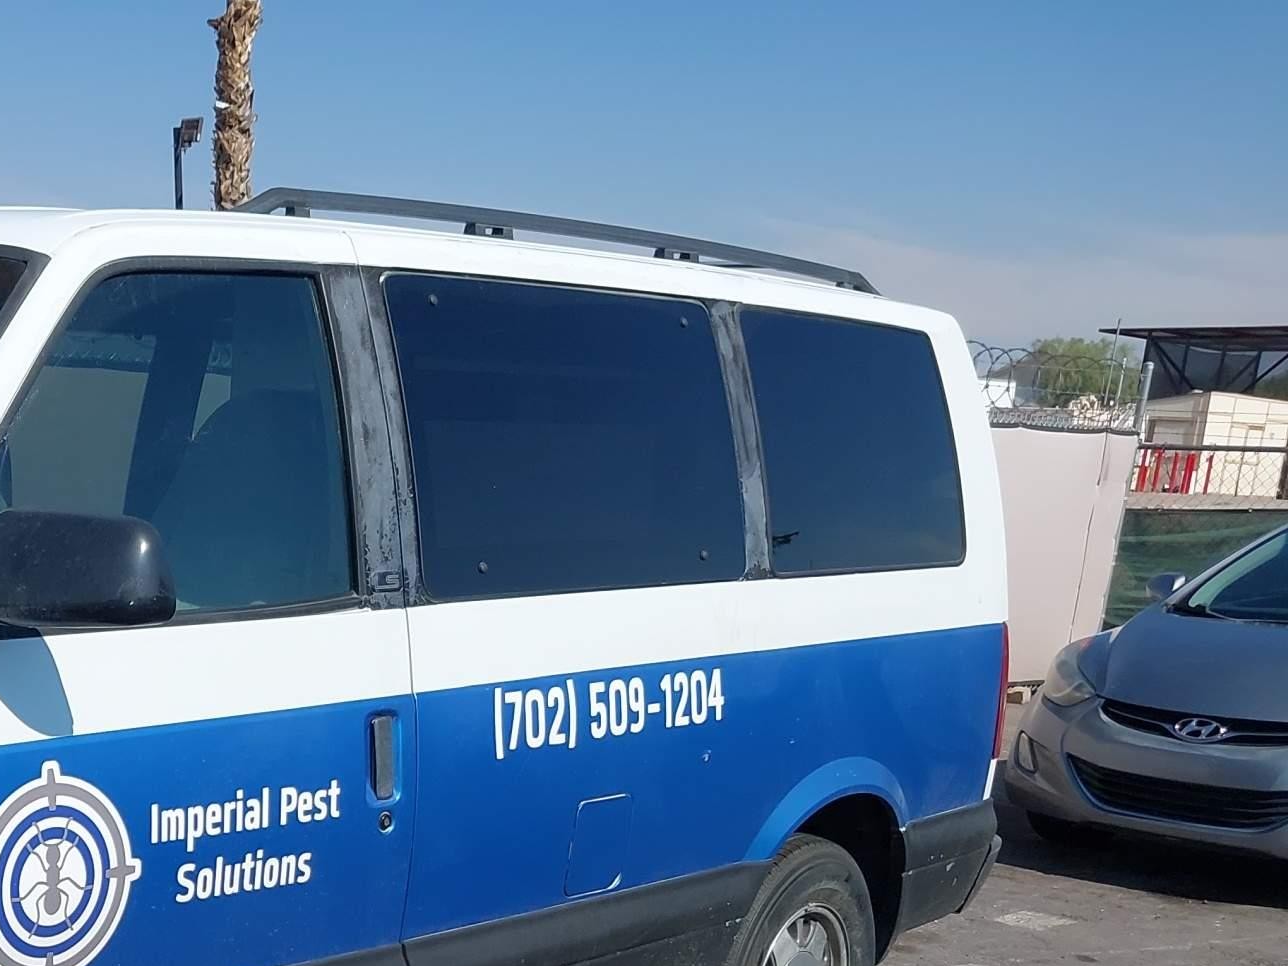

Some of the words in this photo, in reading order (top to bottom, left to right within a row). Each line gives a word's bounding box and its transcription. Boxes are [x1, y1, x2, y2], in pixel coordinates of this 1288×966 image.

[494, 679, 578, 760] (702)
[589, 668, 725, 739] 509-1204
[151, 787, 270, 852] Imperial
[280, 779, 341, 826] Pest
[175, 849, 312, 903] Solutions
